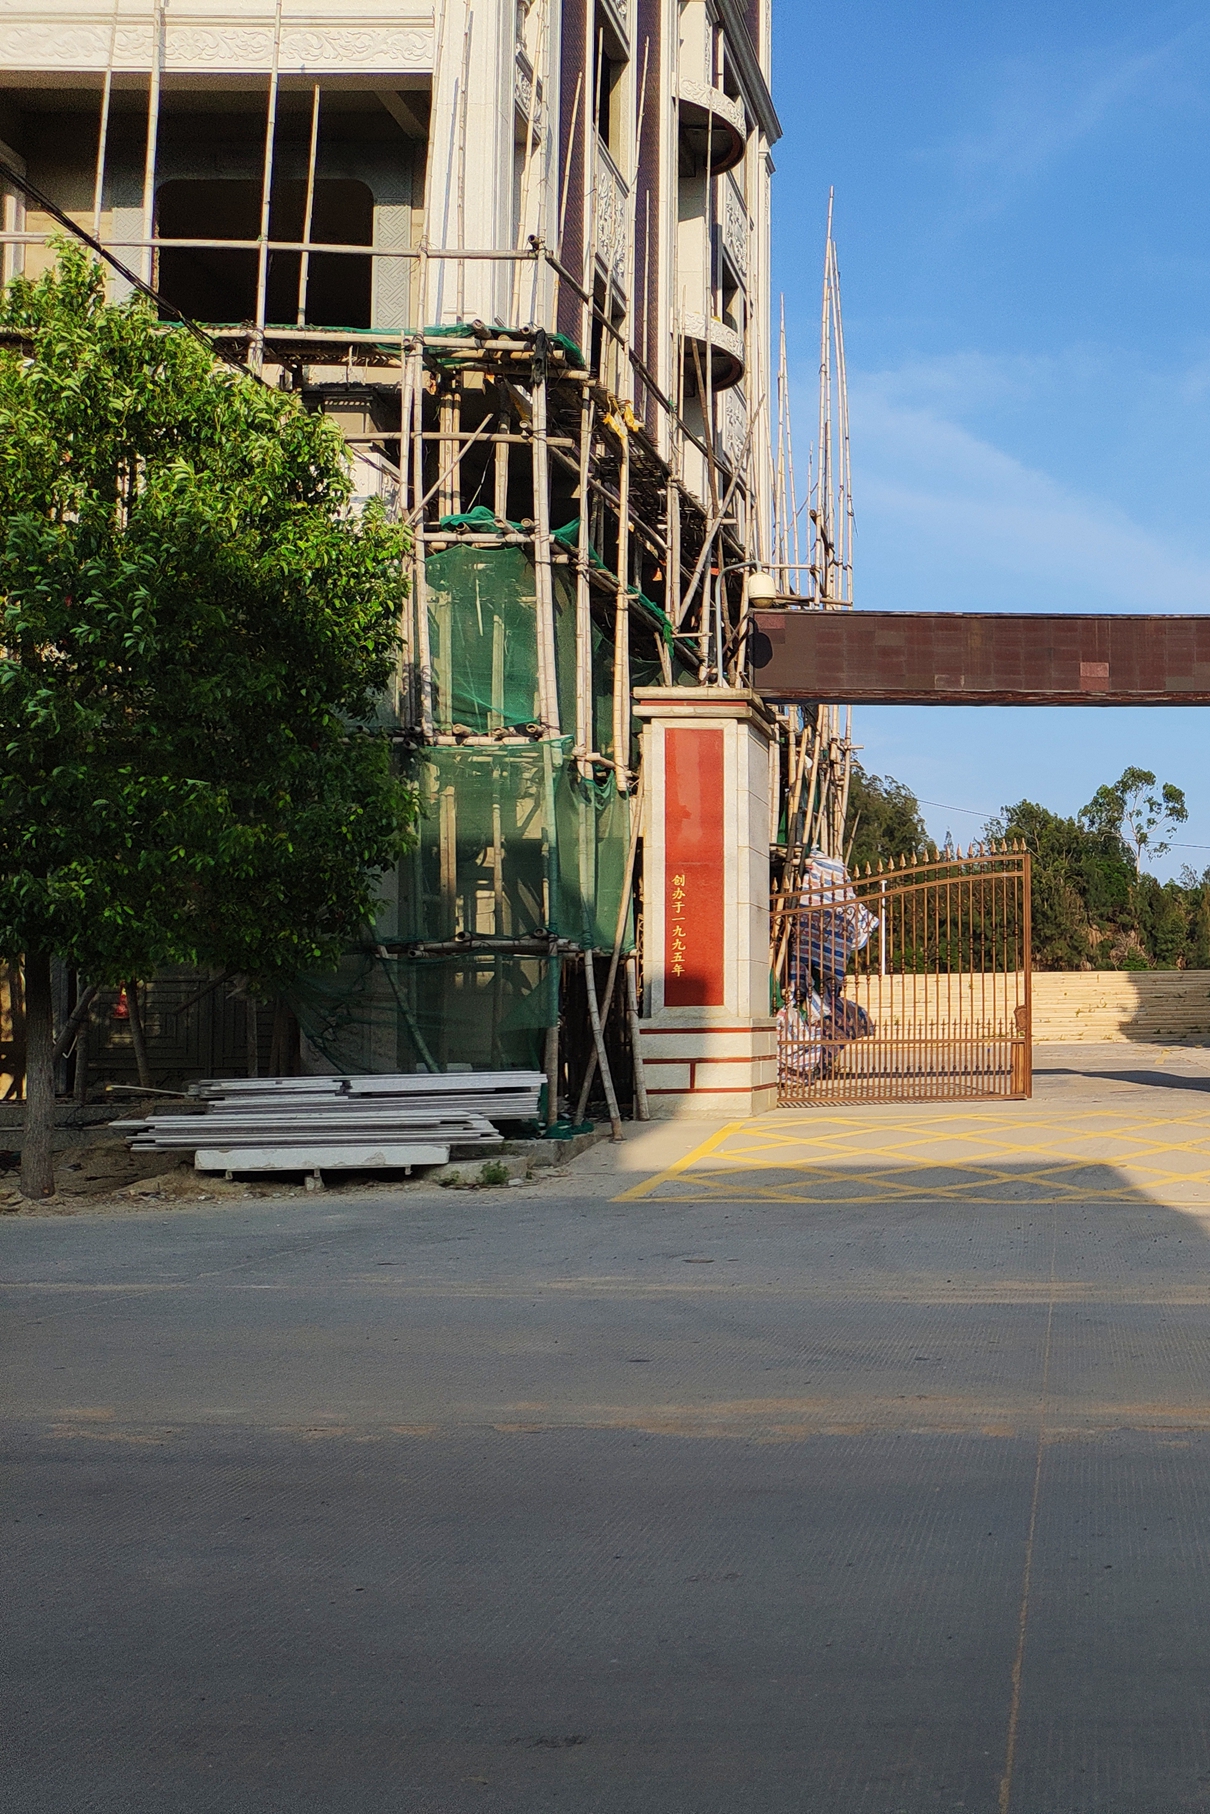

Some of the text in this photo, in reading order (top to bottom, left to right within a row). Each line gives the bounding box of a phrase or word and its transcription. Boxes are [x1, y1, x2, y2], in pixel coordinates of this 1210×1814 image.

[670, 874, 686, 977] 创办于一九九五年
